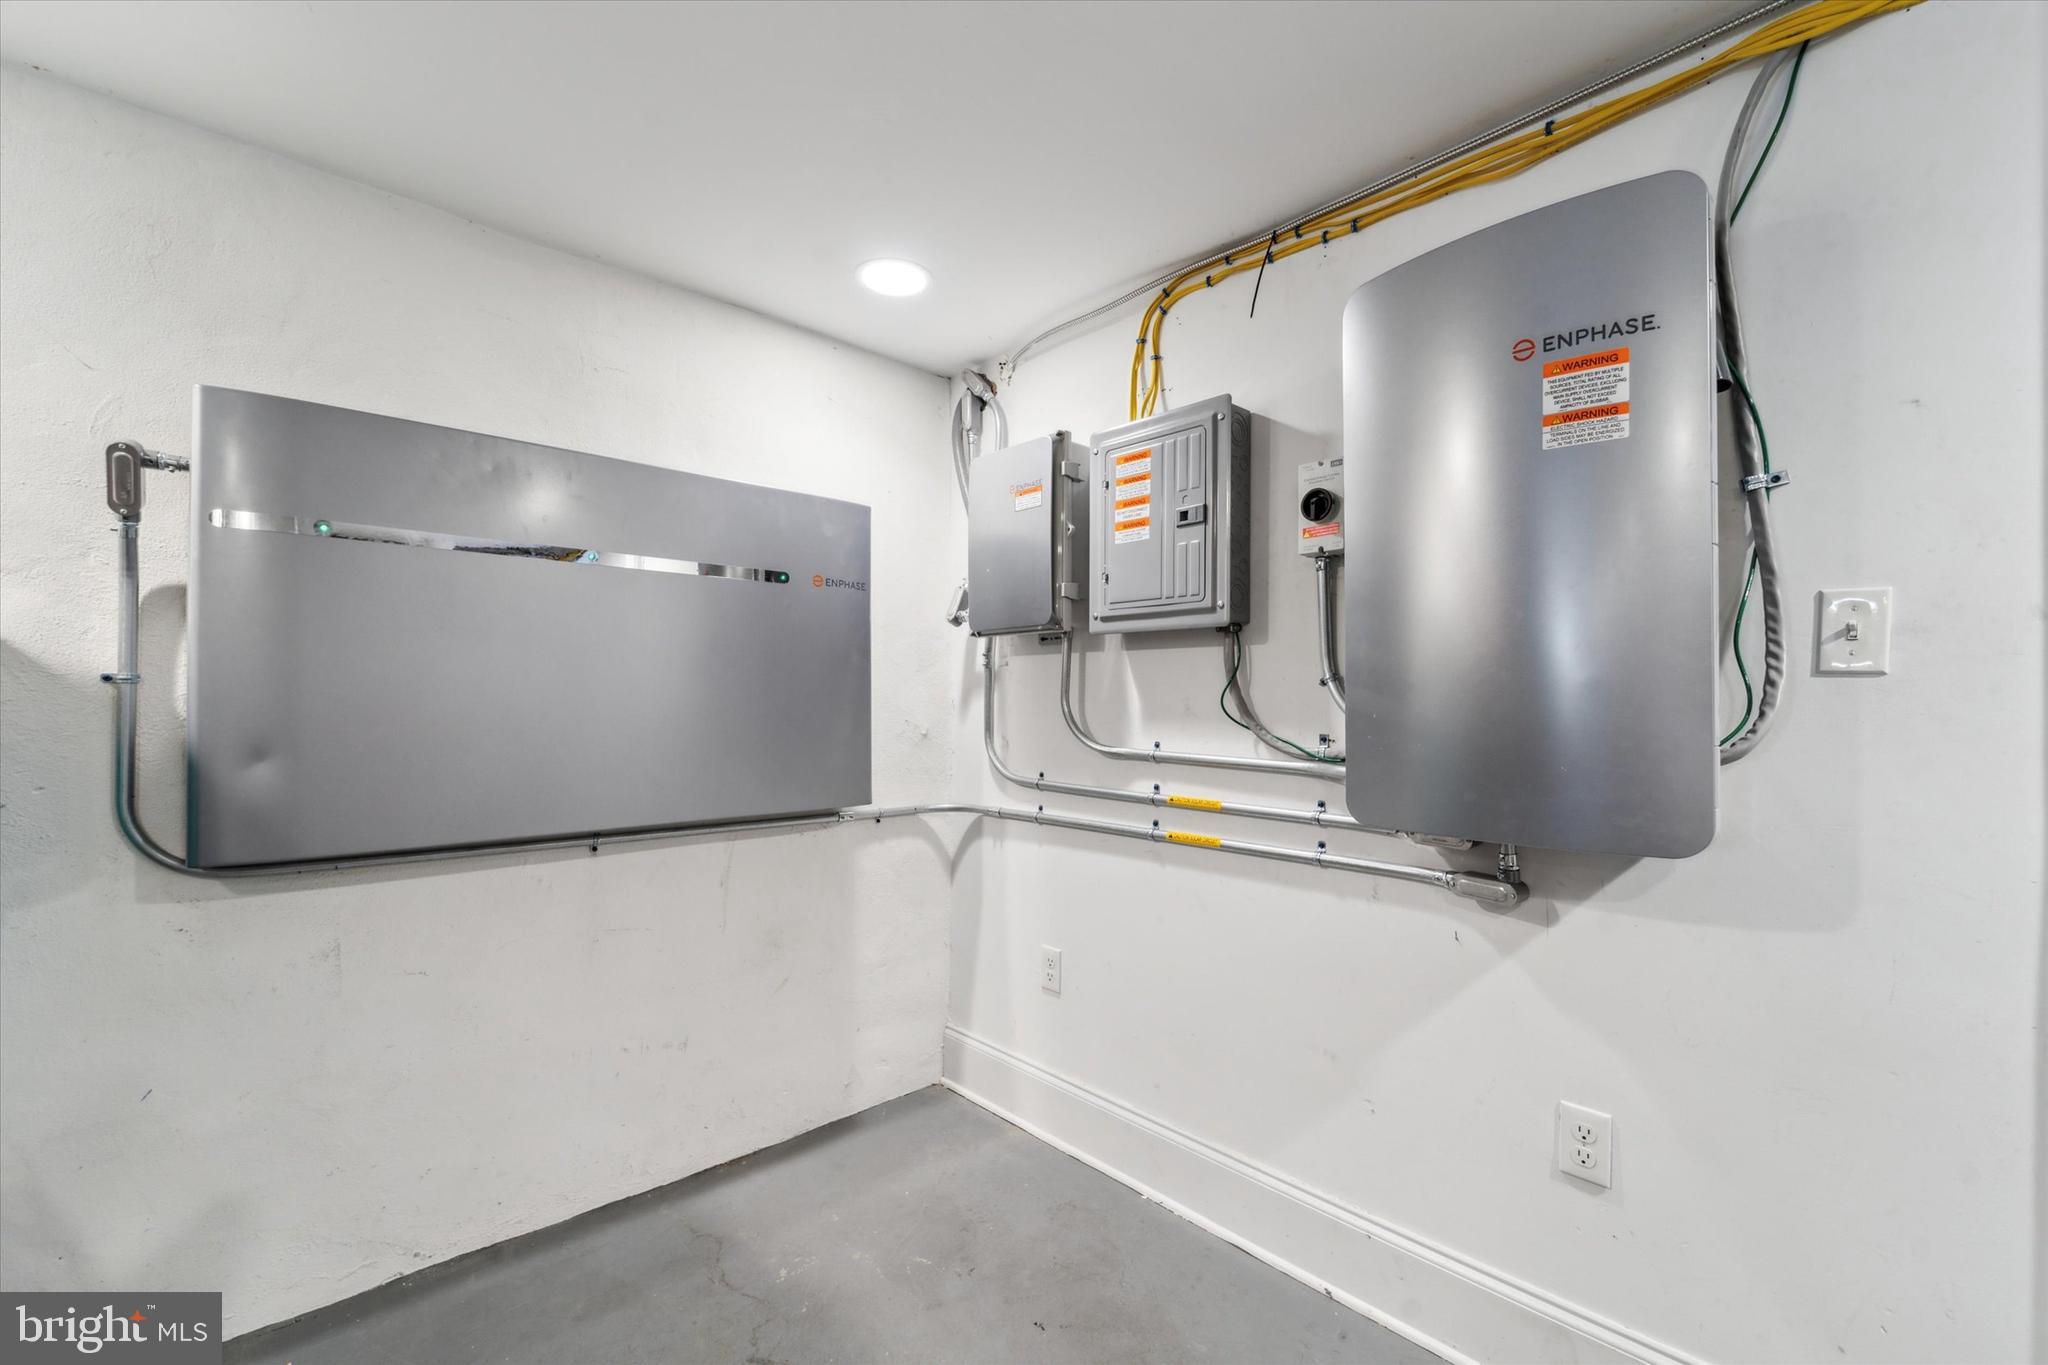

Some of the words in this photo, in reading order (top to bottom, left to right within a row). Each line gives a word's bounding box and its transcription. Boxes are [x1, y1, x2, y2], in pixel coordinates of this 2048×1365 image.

[1562, 353, 1619, 371] WARNING
[1558, 374, 1584, 383] EQUIPMENT
[1588, 375, 1604, 383] RATING
[1544, 385, 1578, 396] OVERCURRENT
[1600, 377, 1627, 386] EXCLUDING
[1583, 384, 1617, 395] OVERCURRENT
[1562, 406, 1619, 423] WARNING
[1595, 427, 1624, 436] ENERGIZED
[825, 578, 867, 591] ENPHASE
